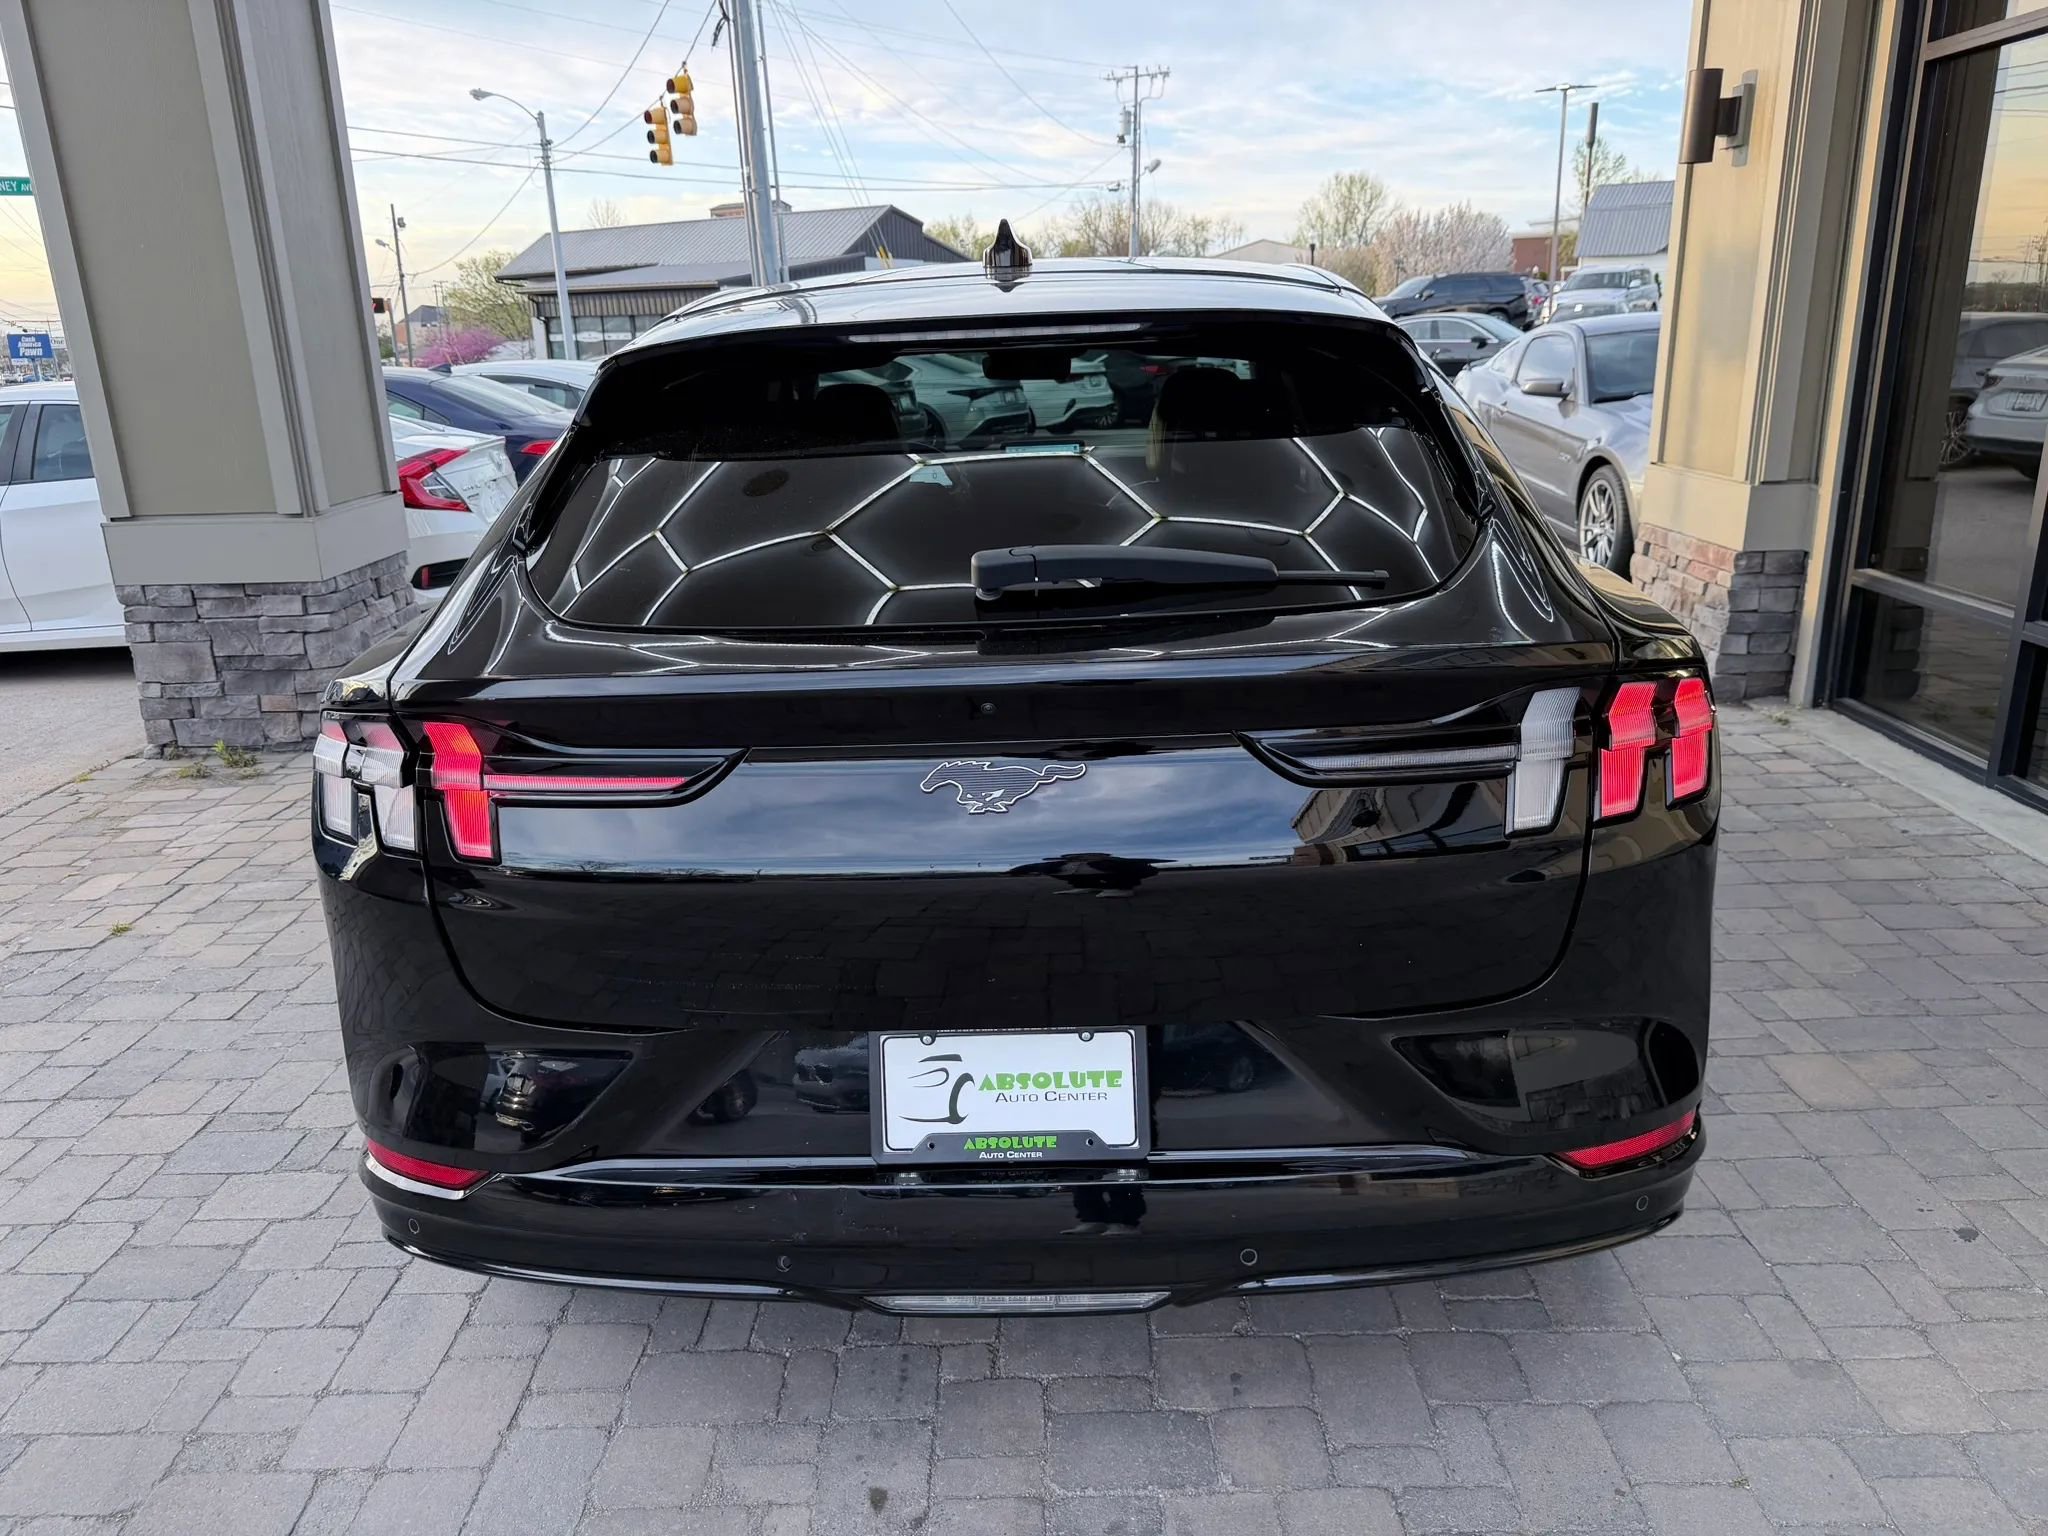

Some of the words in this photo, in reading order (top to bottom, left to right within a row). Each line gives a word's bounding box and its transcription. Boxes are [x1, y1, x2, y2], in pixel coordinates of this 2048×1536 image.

[19, 347, 43, 357] Pawn
[978, 1070, 1123, 1091] ABSOLUTE
[995, 1091, 1039, 1103] AUTO
[1044, 1090, 1108, 1103] CENTER
[963, 1135, 1057, 1150] ABSOLUTE
[979, 1151, 1005, 1159] AUTO
[1006, 1150, 1043, 1159] CENTER
